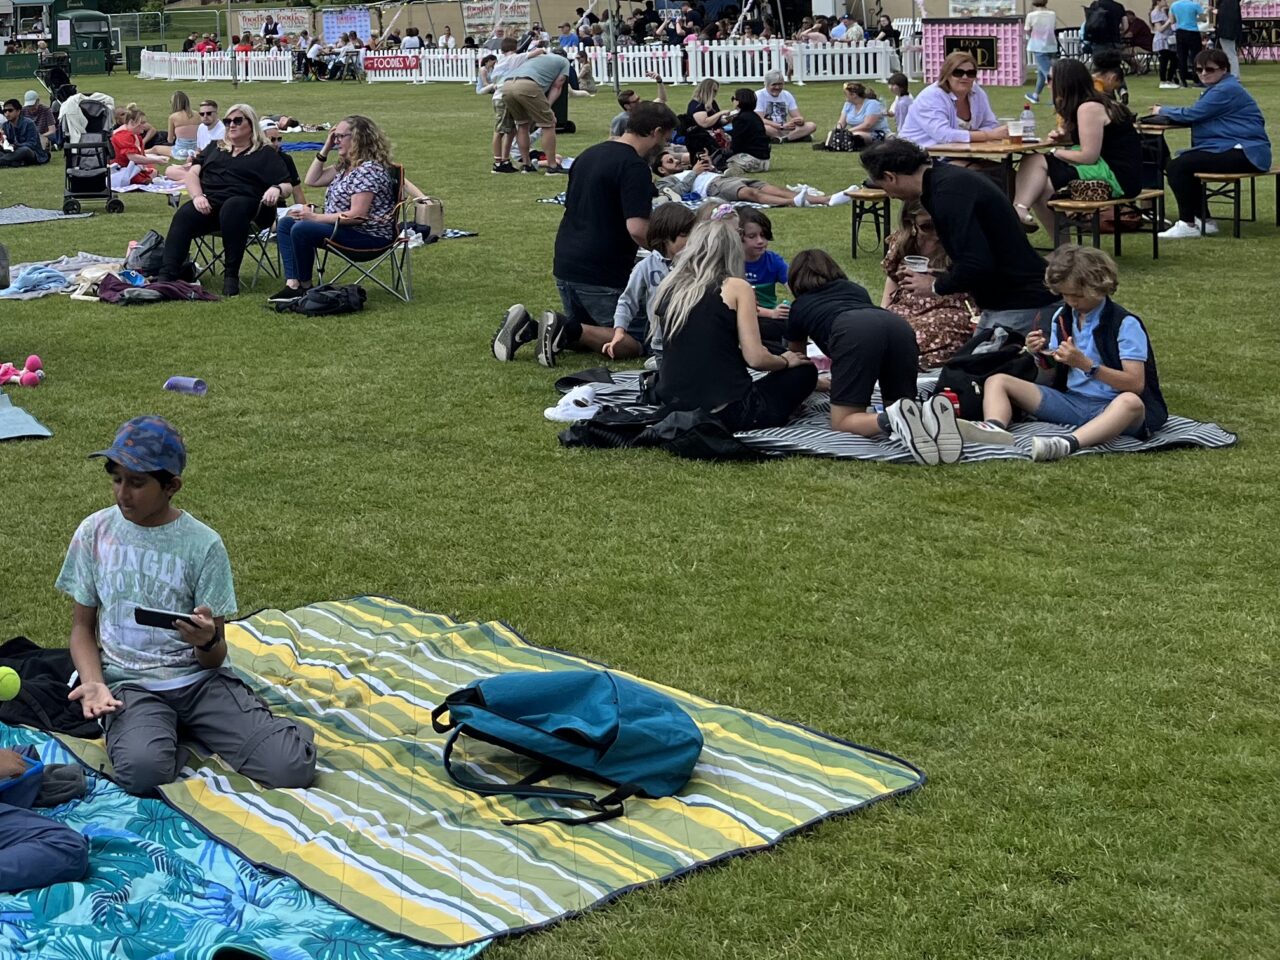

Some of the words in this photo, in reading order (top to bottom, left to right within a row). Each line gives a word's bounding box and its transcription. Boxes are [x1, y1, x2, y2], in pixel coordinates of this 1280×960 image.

[242, 14, 265, 24] foodie
[373, 57, 404, 68] FOODIES
[405, 57, 417, 68] VIP
